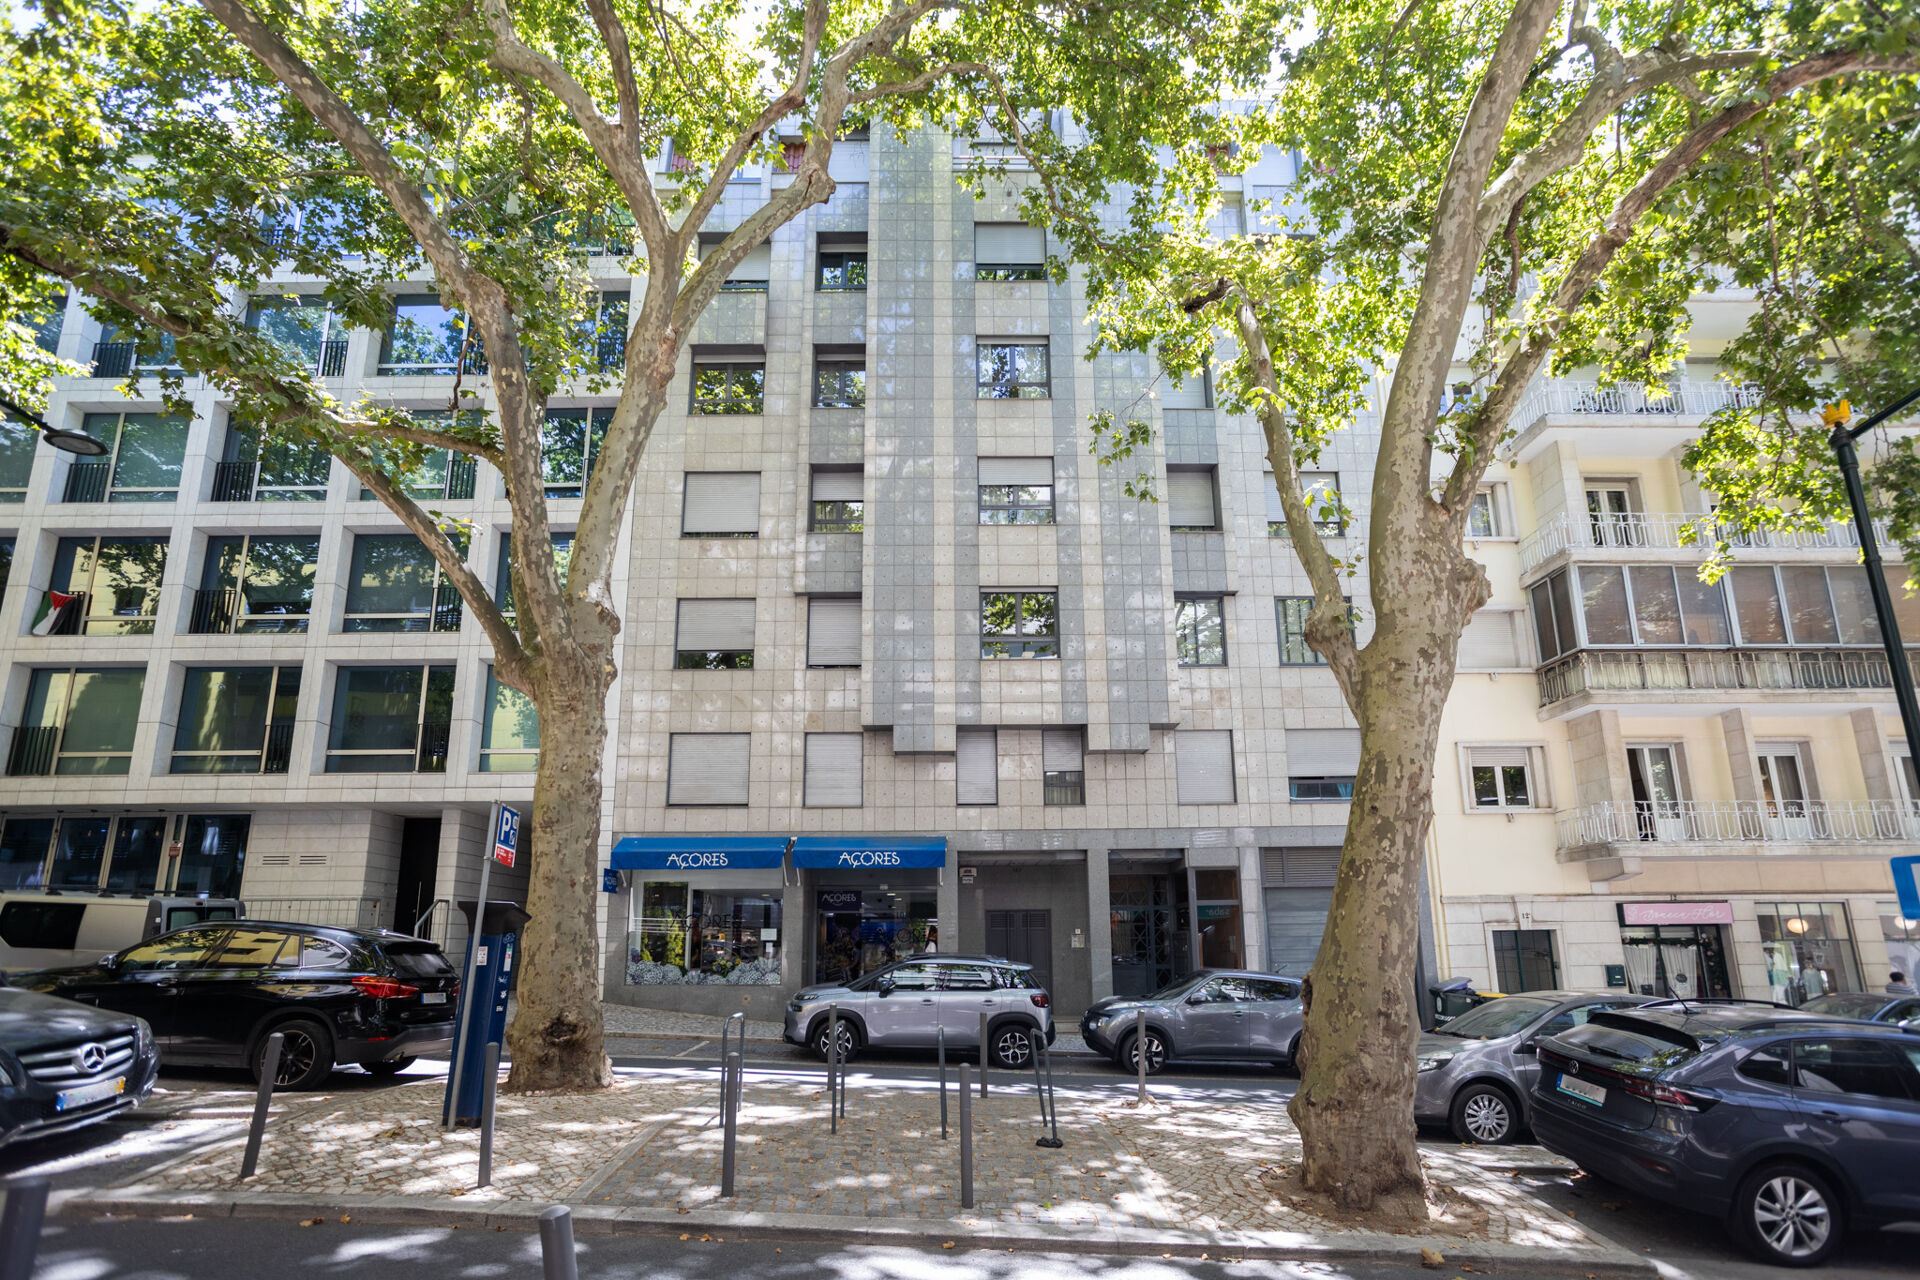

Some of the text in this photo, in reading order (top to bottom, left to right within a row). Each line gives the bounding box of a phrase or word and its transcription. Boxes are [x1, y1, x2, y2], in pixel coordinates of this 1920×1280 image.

[500, 810, 512, 841] P
[666, 852, 729, 869] AÇORES
[838, 851, 901, 868] AÇORES
[821, 893, 857, 903] AÇORES
